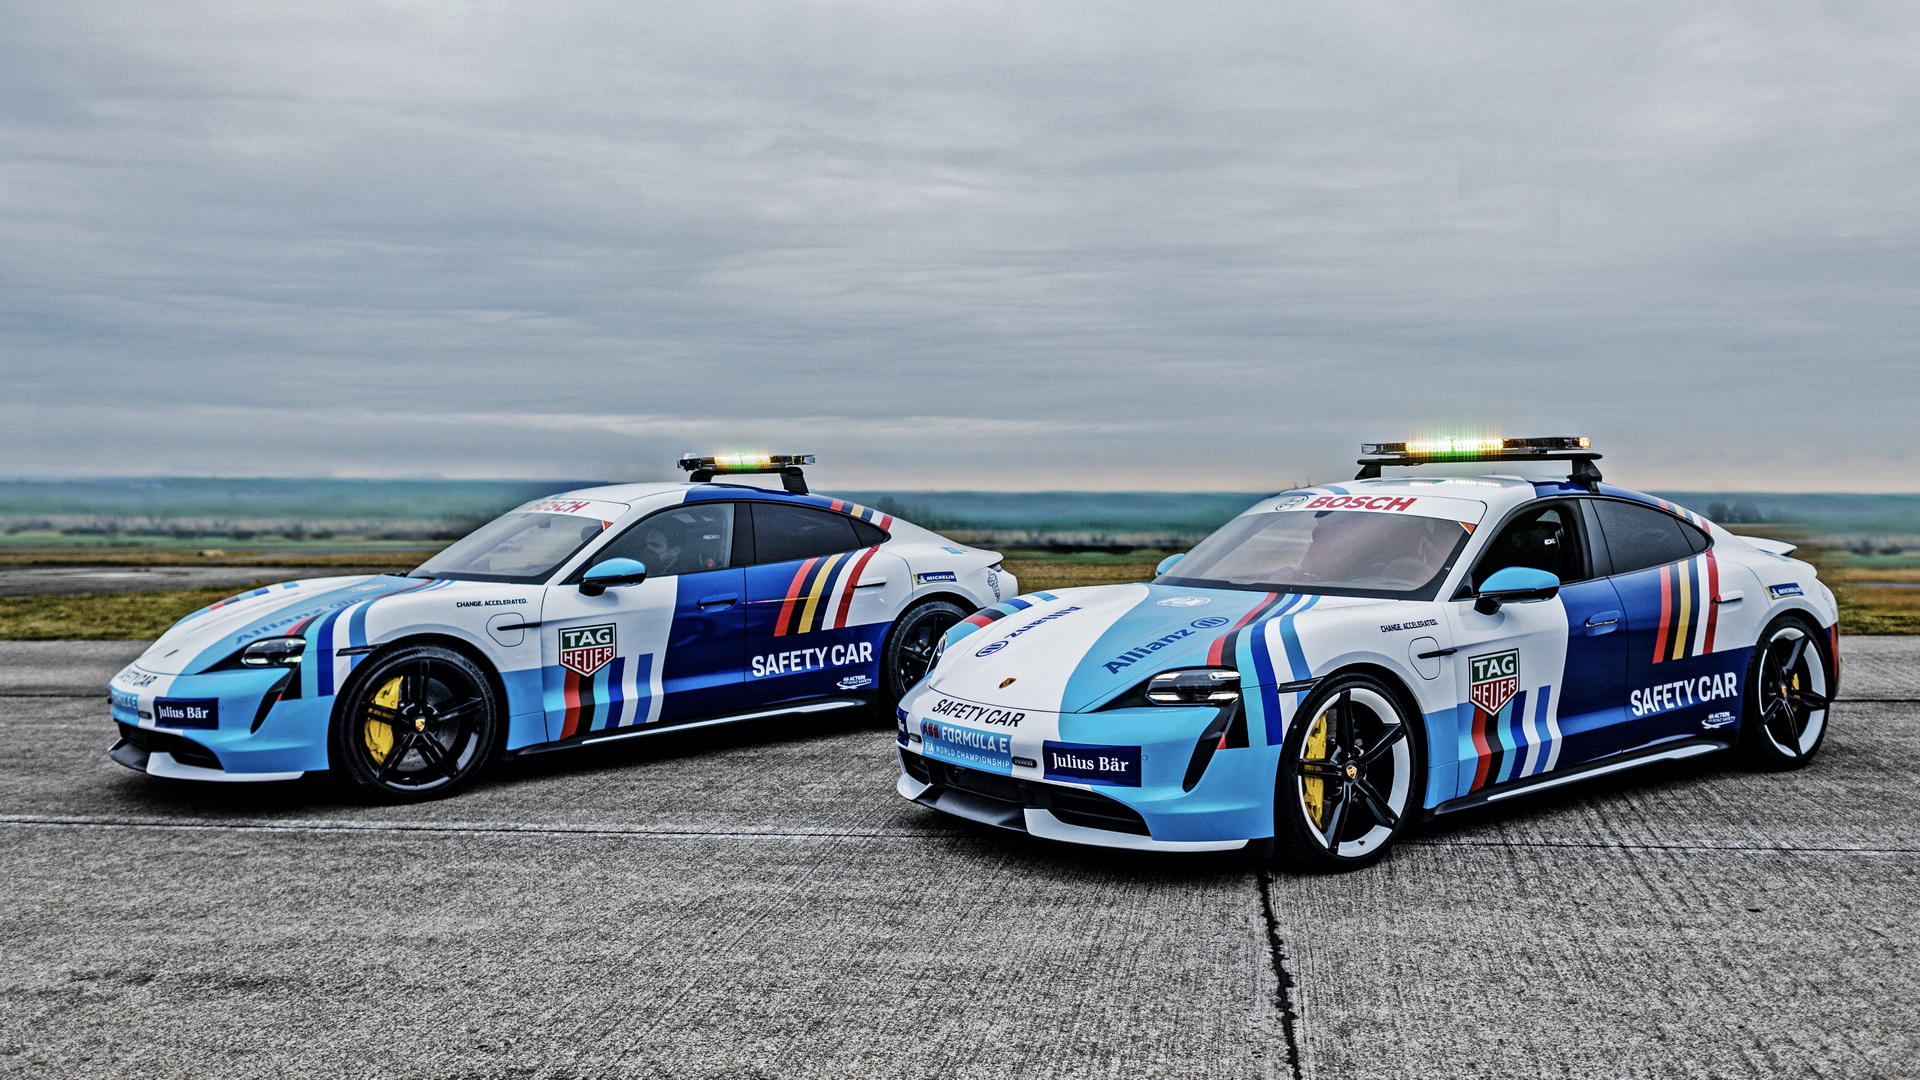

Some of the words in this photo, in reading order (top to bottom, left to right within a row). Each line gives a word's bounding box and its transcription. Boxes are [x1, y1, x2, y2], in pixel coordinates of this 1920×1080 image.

[1305, 496, 1418, 511] BOSCH
[456, 600, 483, 608] CHANGE.
[484, 598, 528, 606] ACCELERATED.
[1004, 606, 1083, 638] Allianz
[564, 629, 611, 647] TAG
[564, 647, 612, 672] HEUER
[751, 646, 828, 677] SAFETY
[831, 641, 873, 666] CAR
[1102, 629, 1196, 675] Allianz
[1474, 656, 1514, 679] TAG
[133, 674, 158, 687] CAR
[1473, 679, 1515, 710] HEUER
[1630, 678, 1696, 716] SAFETY
[1698, 671, 1738, 702] CAR
[158, 705, 184, 719] Julius
[186, 706, 209, 719] Bär
[932, 699, 990, 721] SAFETY
[984, 709, 1026, 727] CAR
[922, 721, 939, 739] ABB
[941, 726, 997, 752] FORMULA
[999, 737, 1008, 753] E
[935, 746, 955, 757] WORLD
[956, 751, 1010, 768] CHAMPIONSHIP
[1052, 752, 1095, 770] Julius
[1098, 756, 1129, 772] Bär
